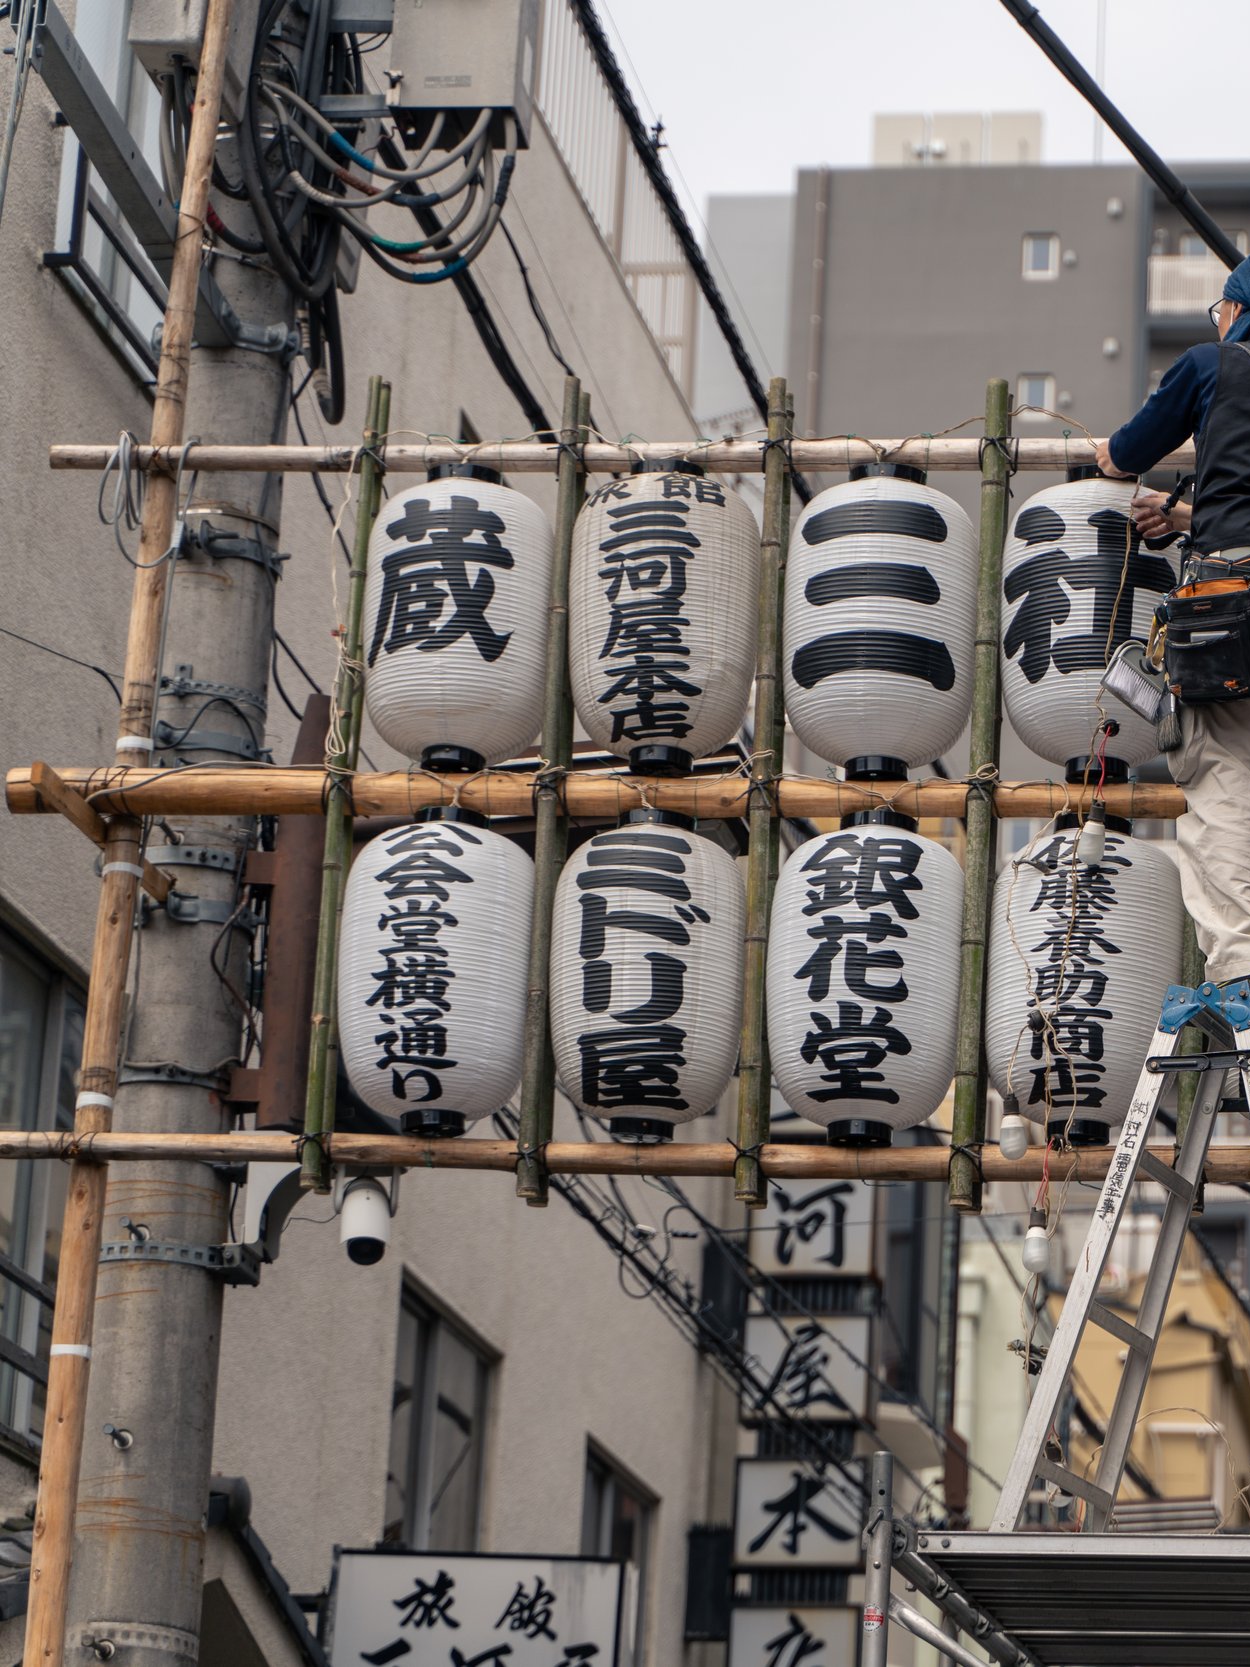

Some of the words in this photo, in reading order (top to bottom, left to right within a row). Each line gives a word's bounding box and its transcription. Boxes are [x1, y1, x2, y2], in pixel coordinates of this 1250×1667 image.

[368, 495, 515, 669] 蔵
[597, 500, 702, 744] 三河屋本店
[791, 500, 956, 692] 三
[1003, 505, 1178, 684] 社
[366, 822, 482, 1102] 公会堂横通り
[576, 832, 711, 1111] ミドリ屋
[794, 832, 925, 1105] 銀花堂
[1027, 836, 1133, 1109] 佐藤養助商店
